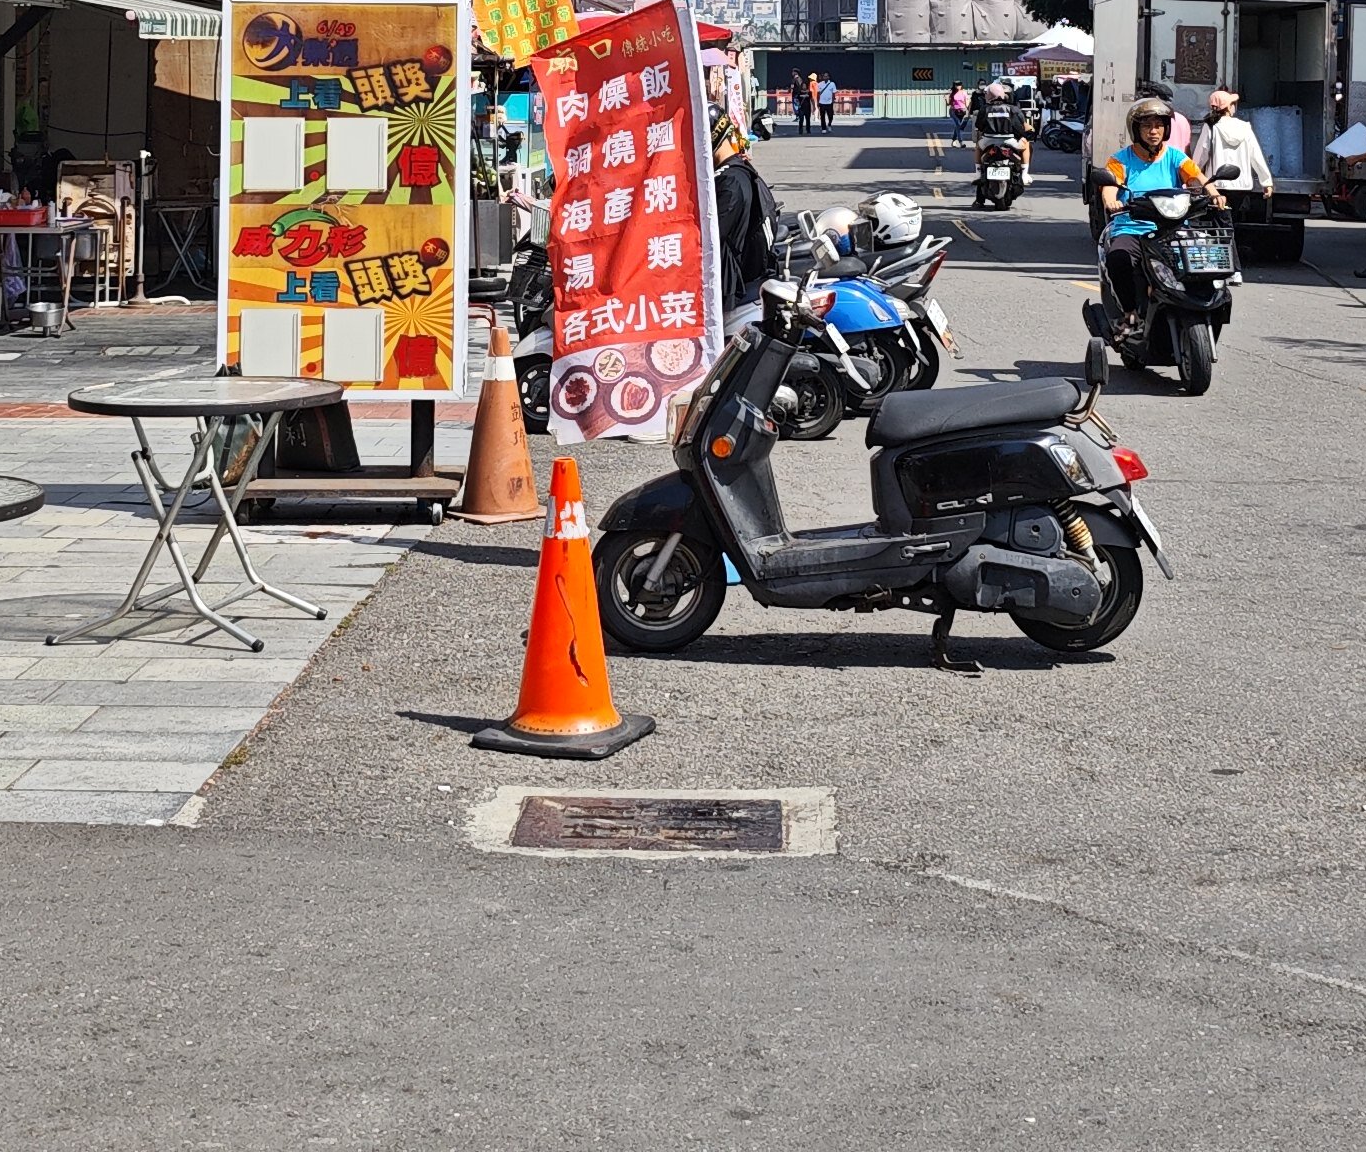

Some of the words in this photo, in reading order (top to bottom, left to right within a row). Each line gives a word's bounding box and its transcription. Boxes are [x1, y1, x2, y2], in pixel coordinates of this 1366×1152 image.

[261, 20, 359, 67] 大樂透
[317, 19, 357, 37] 6/49
[622, 25, 674, 57] 傳統小吃
[280, 78, 341, 110] 上看
[352, 61, 434, 109] 頭獎
[556, 61, 673, 128] 肉燥飯
[397, 144, 441, 187] 億
[564, 117, 676, 182] 鍋燒麵
[560, 175, 679, 237] 海產粥
[233, 222, 367, 259] 威力彩
[277, 270, 340, 303] 上看
[346, 252, 432, 302] 頭獎
[561, 289, 698, 347] 各式小菜
[394, 334, 438, 378] 億
